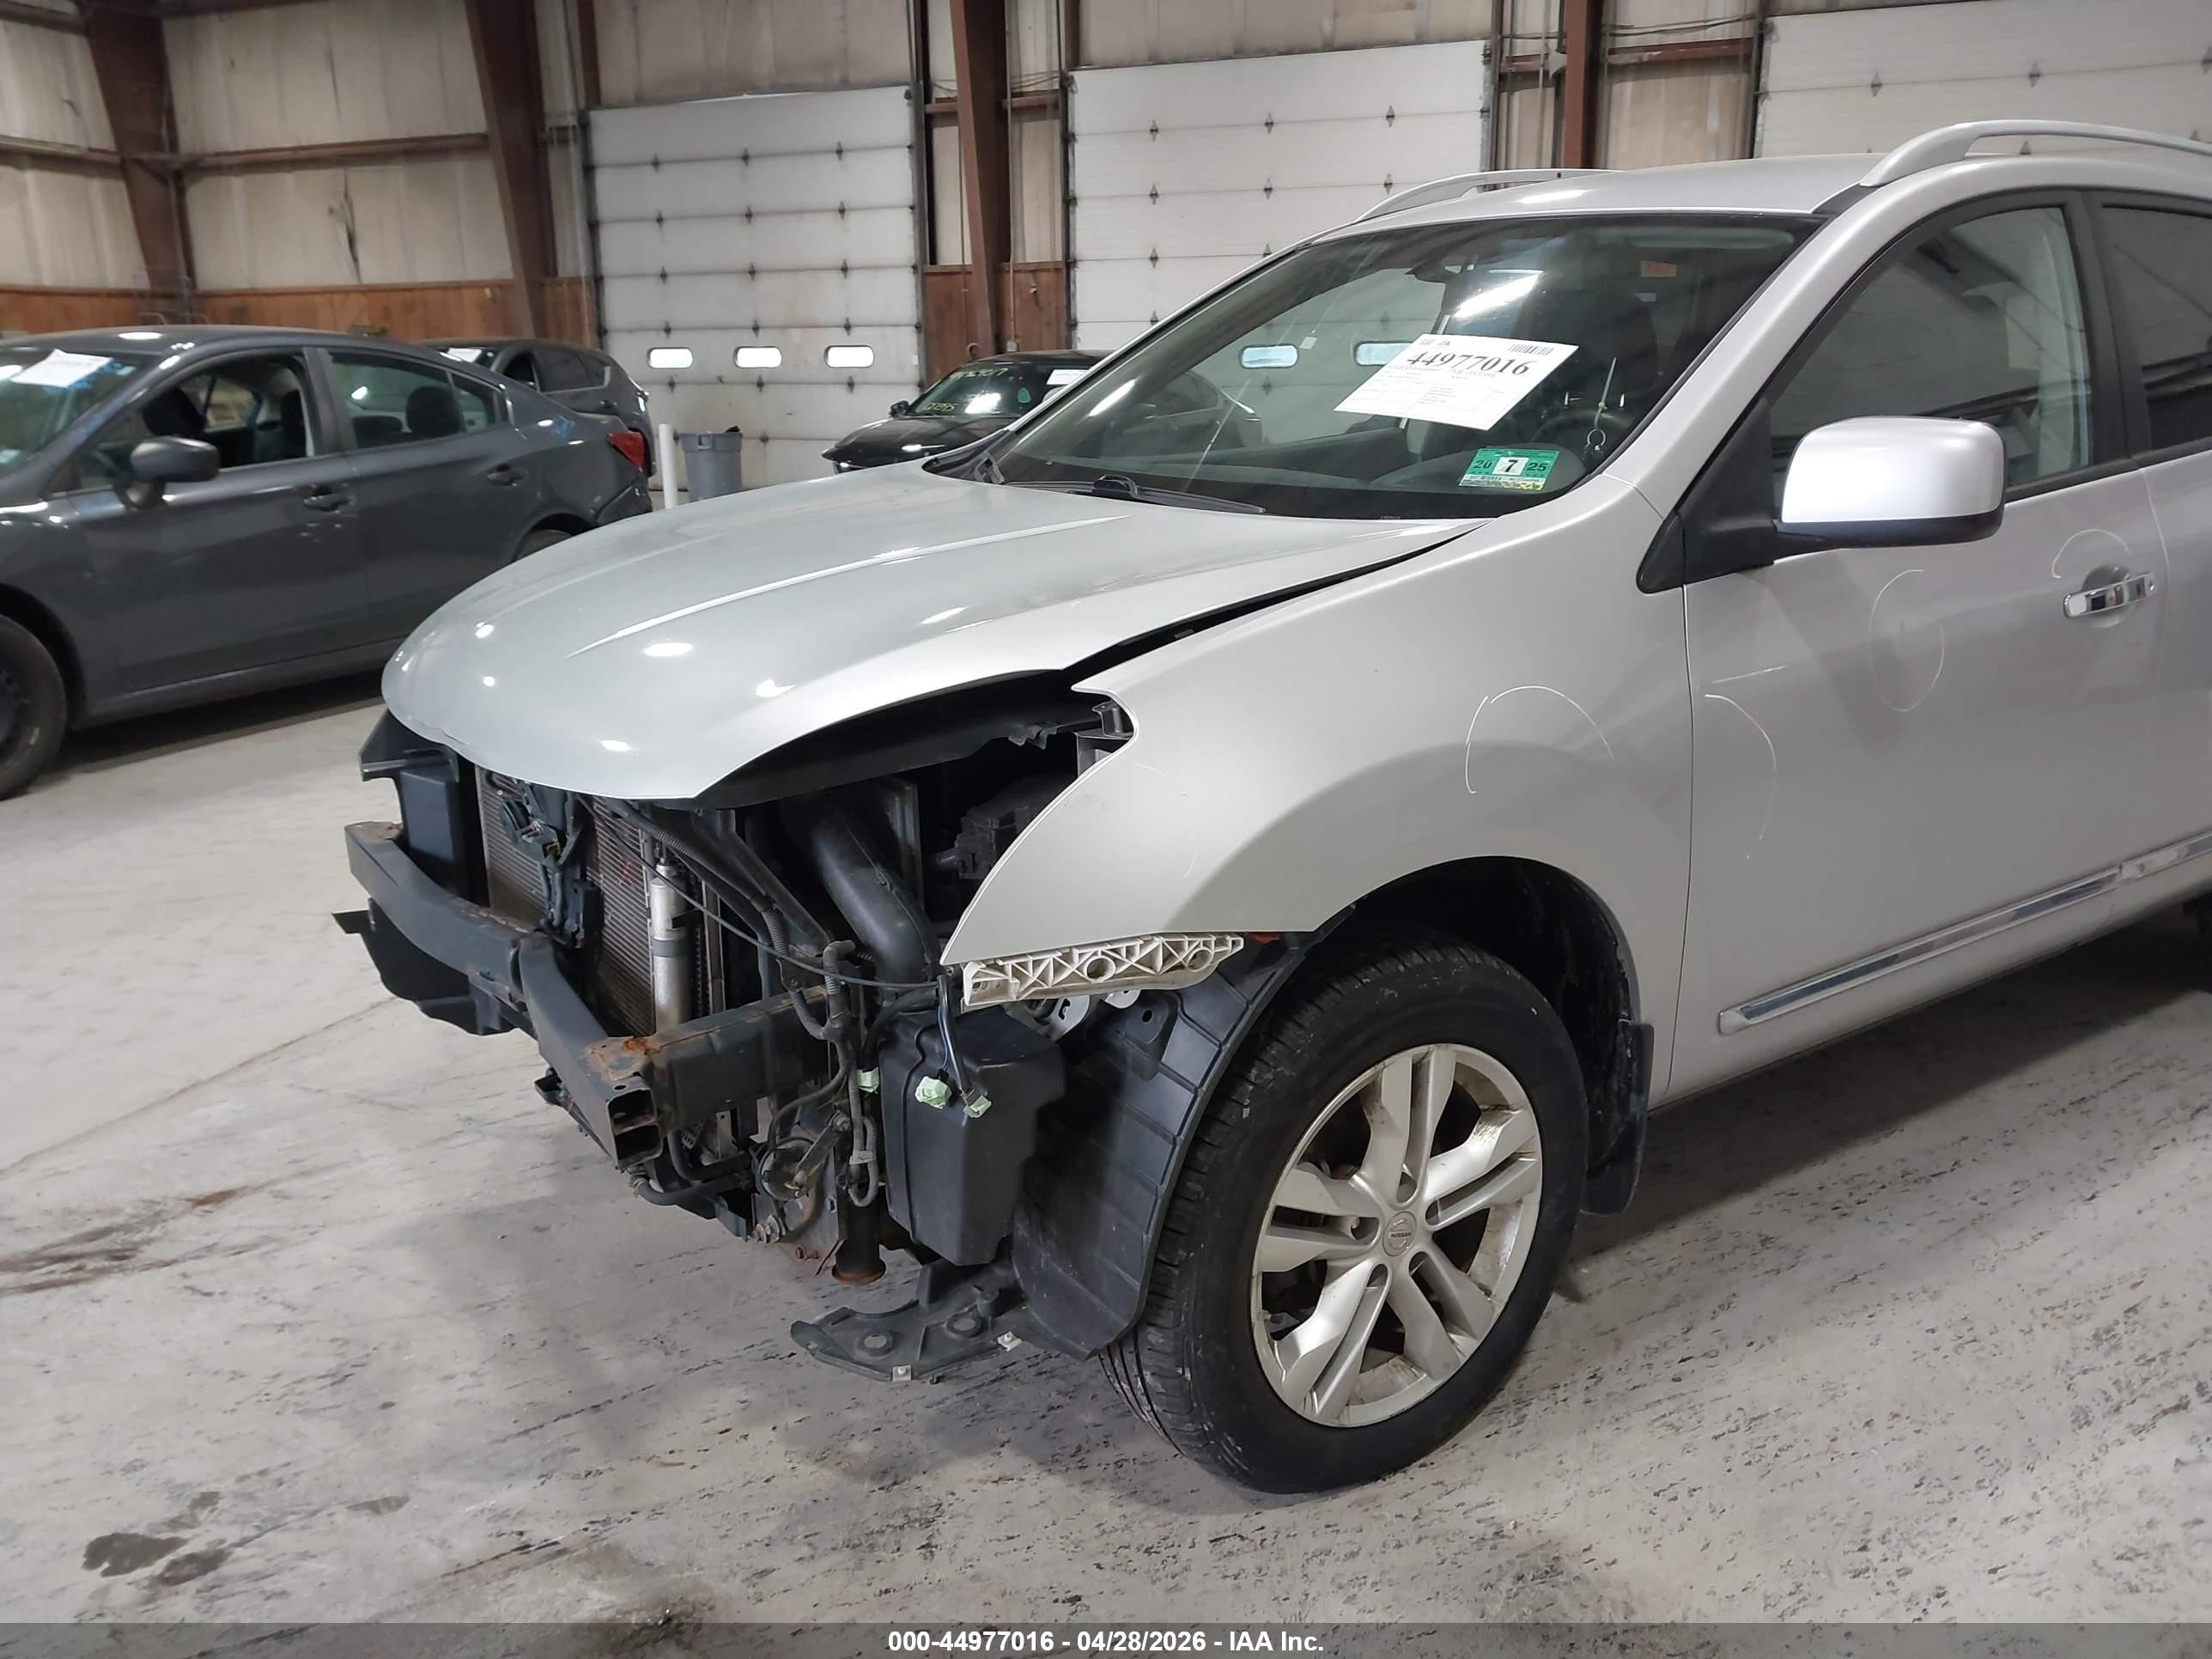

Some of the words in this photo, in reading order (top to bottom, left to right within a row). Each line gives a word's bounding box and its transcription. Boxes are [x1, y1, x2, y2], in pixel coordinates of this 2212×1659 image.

[1407, 351, 1537, 375] 44977016
[1474, 459, 1492, 469] 20
[1504, 459, 1519, 472] 7
[1527, 463, 1547, 471] 25
